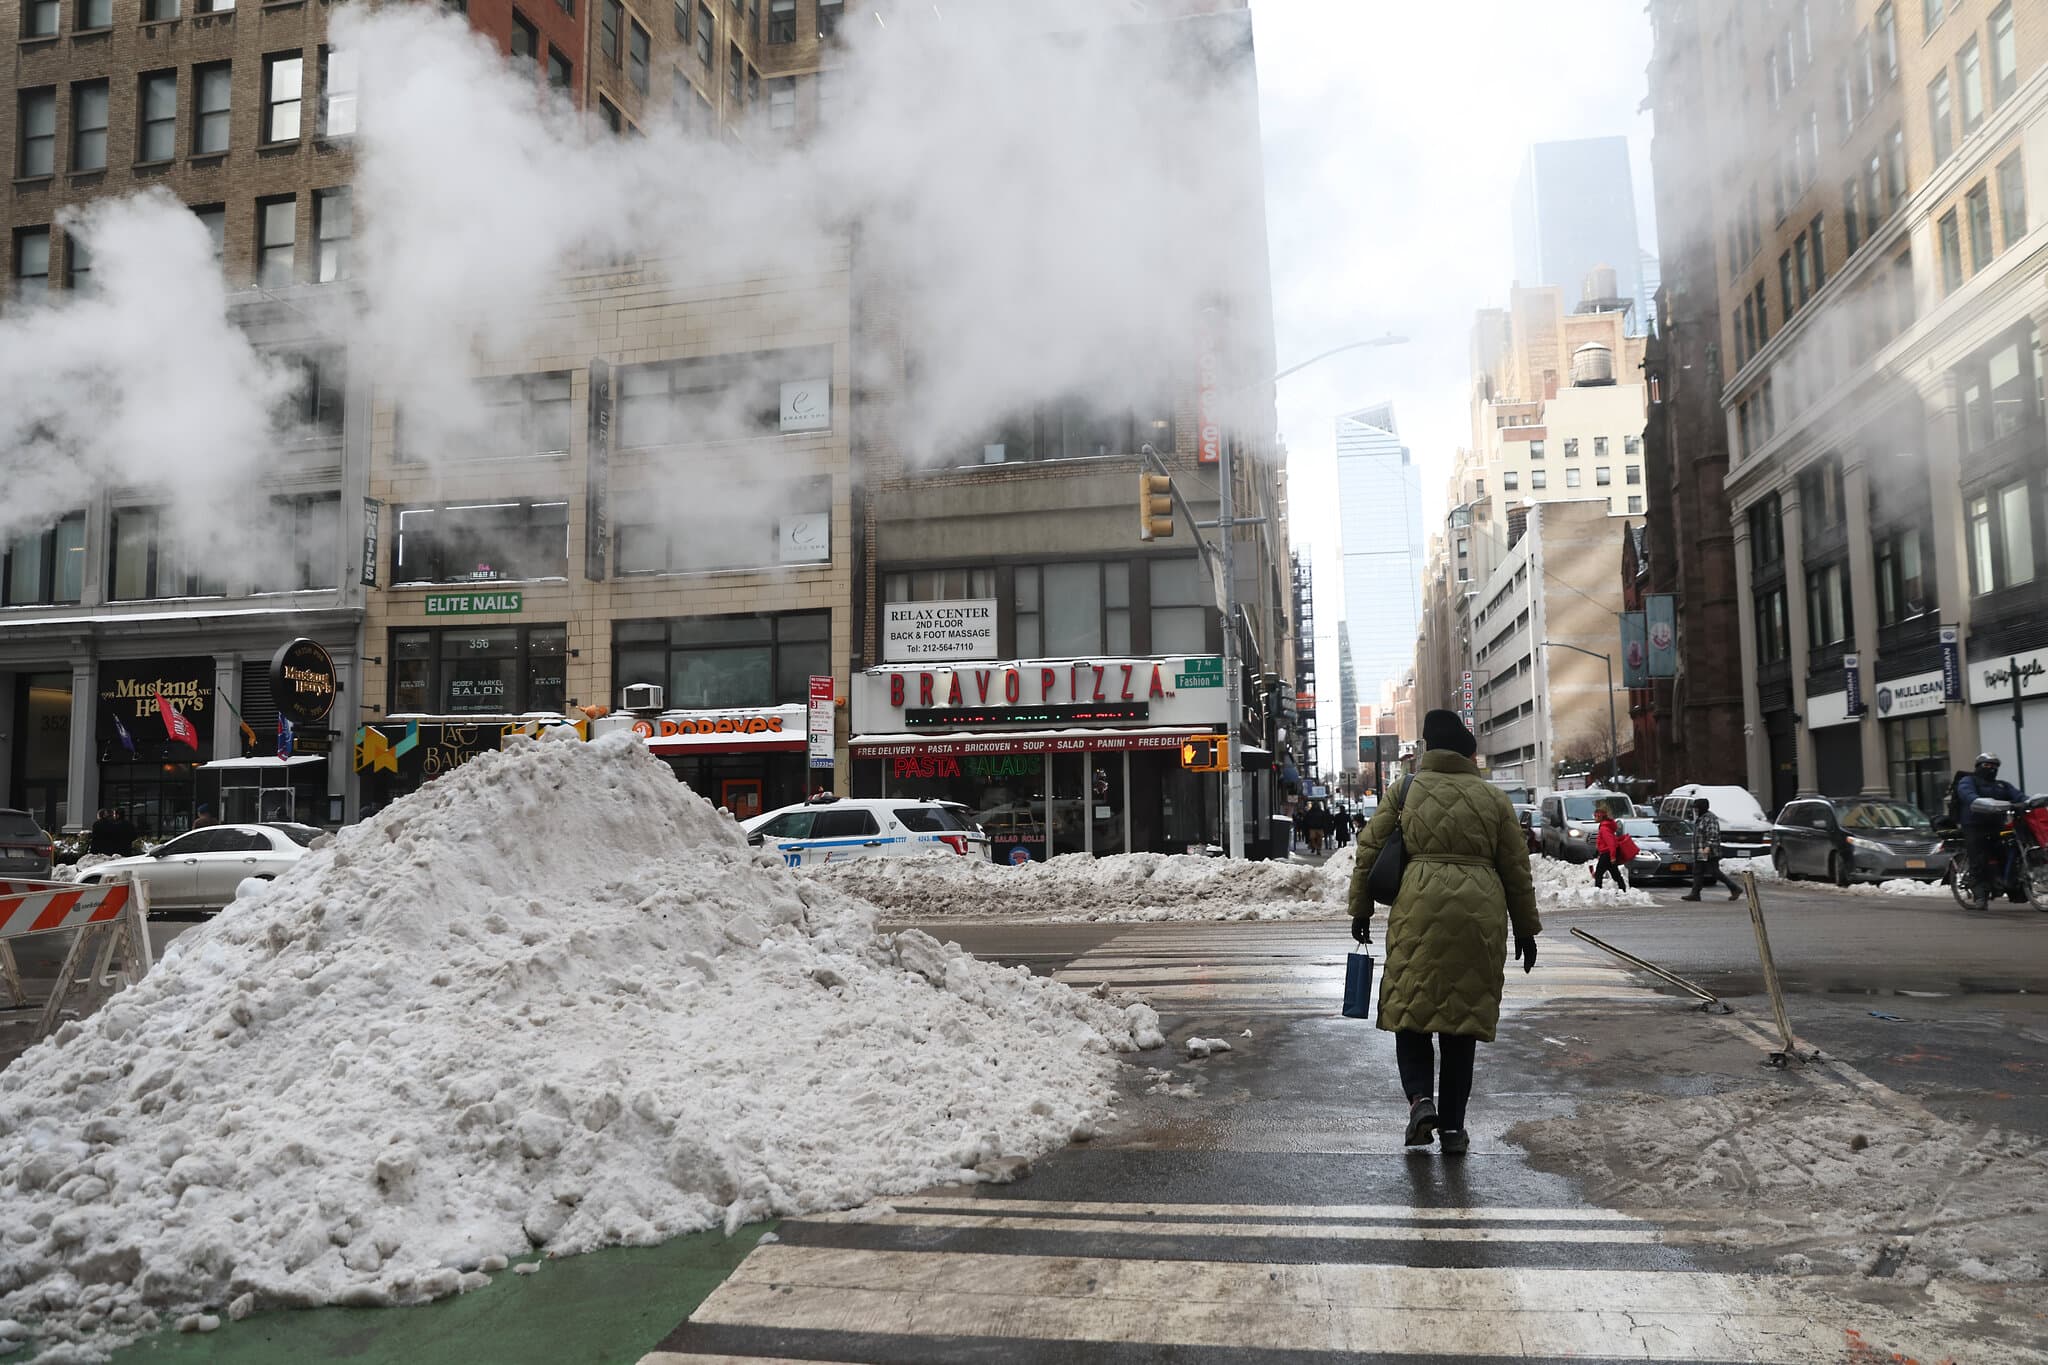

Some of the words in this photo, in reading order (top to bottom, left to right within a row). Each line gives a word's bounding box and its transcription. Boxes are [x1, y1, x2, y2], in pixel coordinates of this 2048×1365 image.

[365, 511, 377, 580] NAILS
[428, 598, 469, 612] ELITE
[473, 595, 518, 610] NAILS
[891, 609, 934, 621] RELAX
[937, 607, 990, 619] CENTER
[916, 621, 932, 629] 2ND
[934, 620, 964, 628] FLOOR
[891, 632, 914, 640] BACK
[916, 631, 921, 639] &
[923, 631, 946, 639] FOOT
[948, 629, 990, 638] MASSAGE
[470, 639, 489, 648] 356
[907, 644, 921, 653] Tel:
[923, 642, 974, 652] 212-564-7110
[1196, 660, 1202, 672] 7
[891, 669, 1019, 706] BRAVO
[1041, 664, 1164, 703] PIZZA
[1180, 675, 1210, 687] Fashion
[116, 679, 198, 700] Mustang
[453, 687, 504, 695] SALON
[1464, 673, 1472, 709] PARK
[1895, 681, 1943, 699] MULLIGAN
[878, 746, 916, 755] DELIVERY
[928, 744, 952, 753] PASTA
[965, 743, 1010, 752] BRICKOVEN
[1023, 741, 1045, 750] SOUP
[1057, 740, 1085, 749] SALAD
[1097, 739, 1126, 747] PANINI
[1138, 738, 1160, 746] FREE
[895, 756, 961, 779] PASTA
